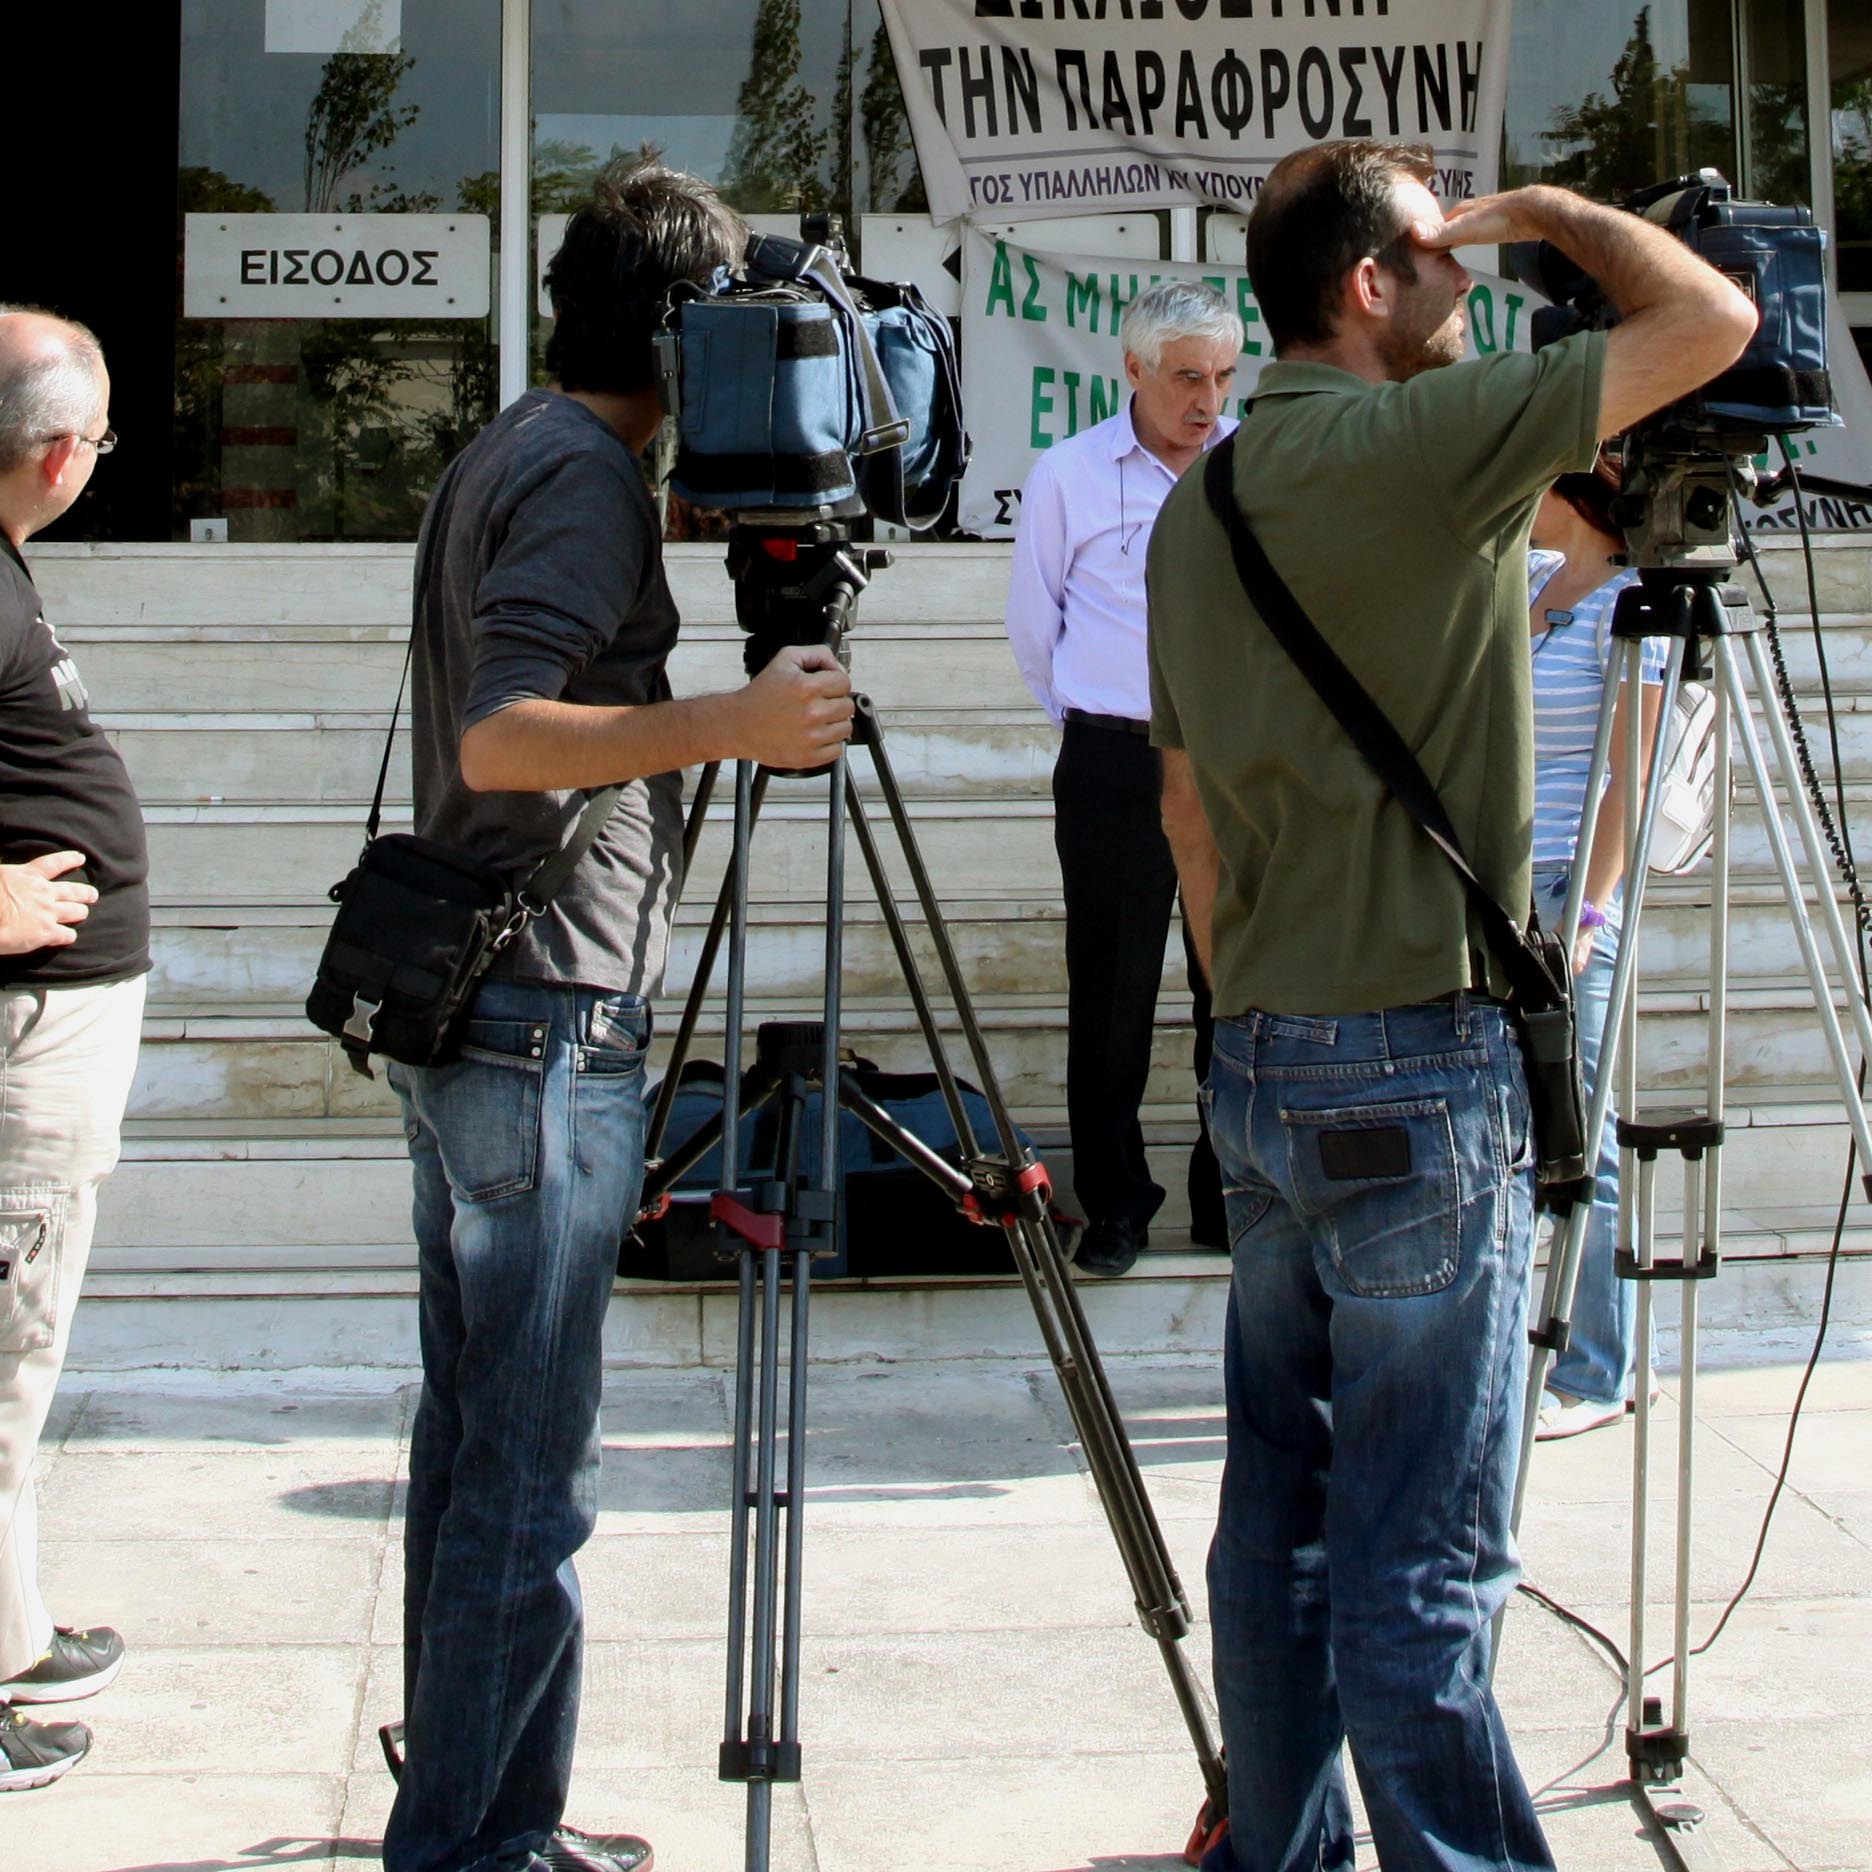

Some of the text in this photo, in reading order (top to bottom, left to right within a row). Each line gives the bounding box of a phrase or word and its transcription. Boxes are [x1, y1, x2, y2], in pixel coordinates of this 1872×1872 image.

[919, 41, 1483, 140] ΤΗΝ ΠΑΡΑΦΡΟΣΥΝΗ
[1018, 163, 1161, 202] ΥΠΑΛΛΗΛΩΝ
[240, 248, 440, 287] ΕΙΣΟΔΟΣ
[985, 240, 1048, 322] ΑΣ
